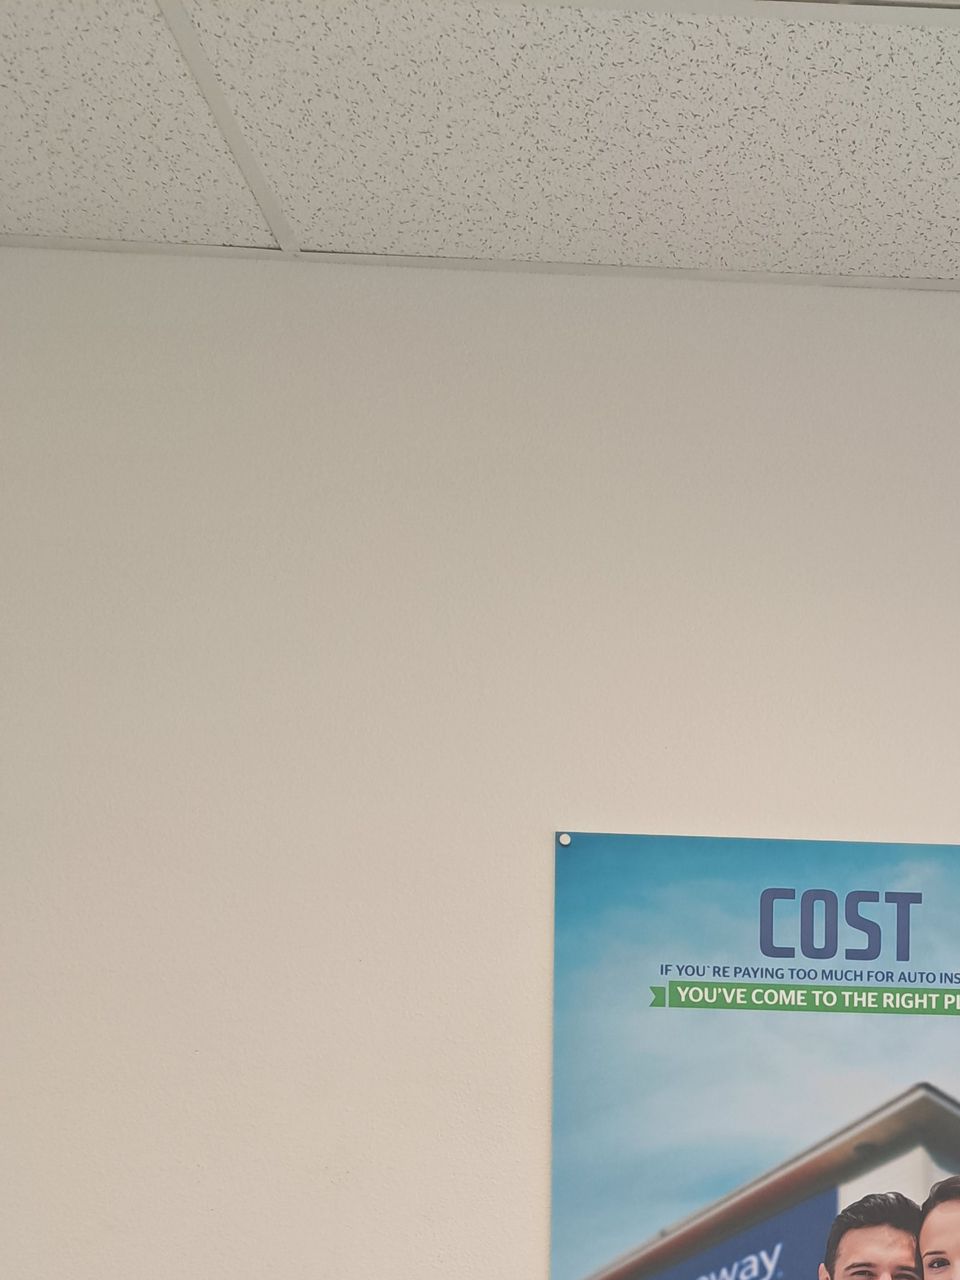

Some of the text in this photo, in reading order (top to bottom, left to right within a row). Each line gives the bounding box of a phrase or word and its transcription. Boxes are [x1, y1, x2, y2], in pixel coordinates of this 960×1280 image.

[759, 887, 922, 962] COST
[660, 964, 673, 976] IF
[733, 966, 785, 980] PAYING
[788, 968, 818, 980] TOO
[821, 969, 863, 982] MUCH
[867, 970, 894, 983] FOR
[897, 971, 936, 984] AUTO
[751, 988, 807, 1006] COME
[811, 990, 837, 1007] TO
[841, 991, 878, 1008] THE
[882, 992, 940, 1009] RIGHT
